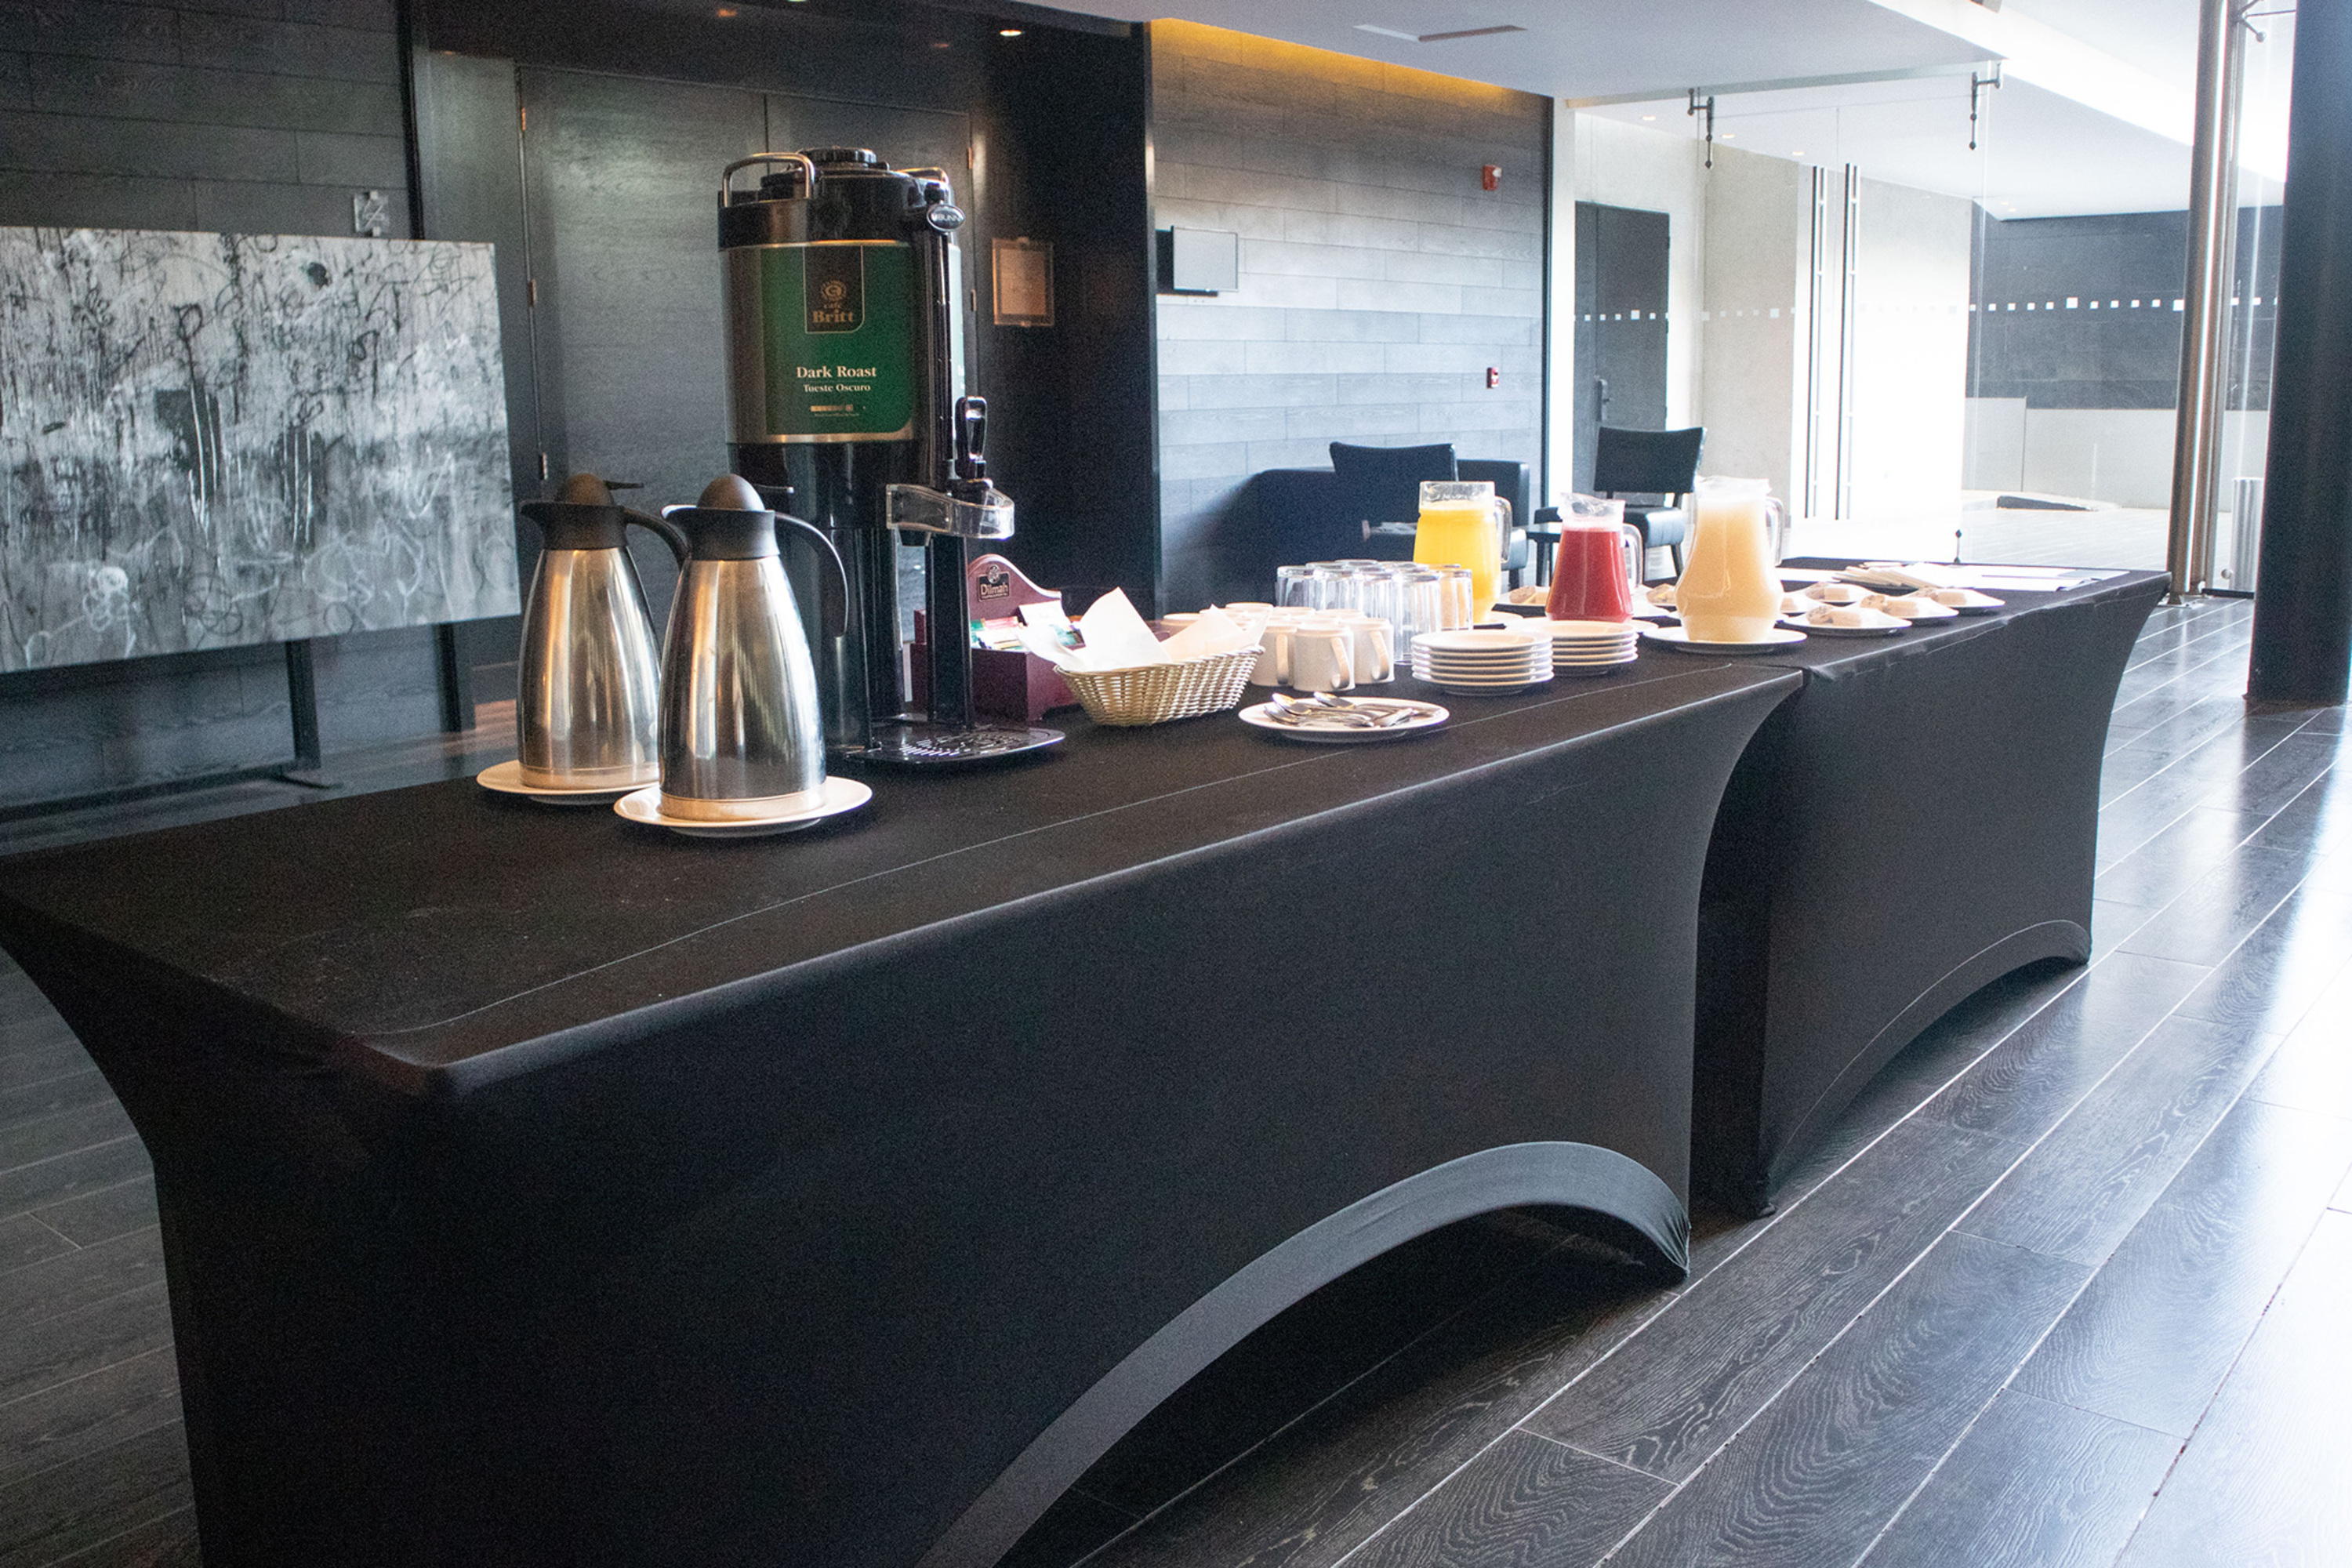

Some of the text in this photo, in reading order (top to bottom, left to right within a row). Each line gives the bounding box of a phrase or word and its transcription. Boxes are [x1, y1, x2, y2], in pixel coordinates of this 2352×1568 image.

[812, 309, 854, 323] Britt
[797, 365, 877, 378] Dark Roast
[803, 383, 871, 393] Tueste Oscuro
[980, 582, 1009, 595] Dilmah
